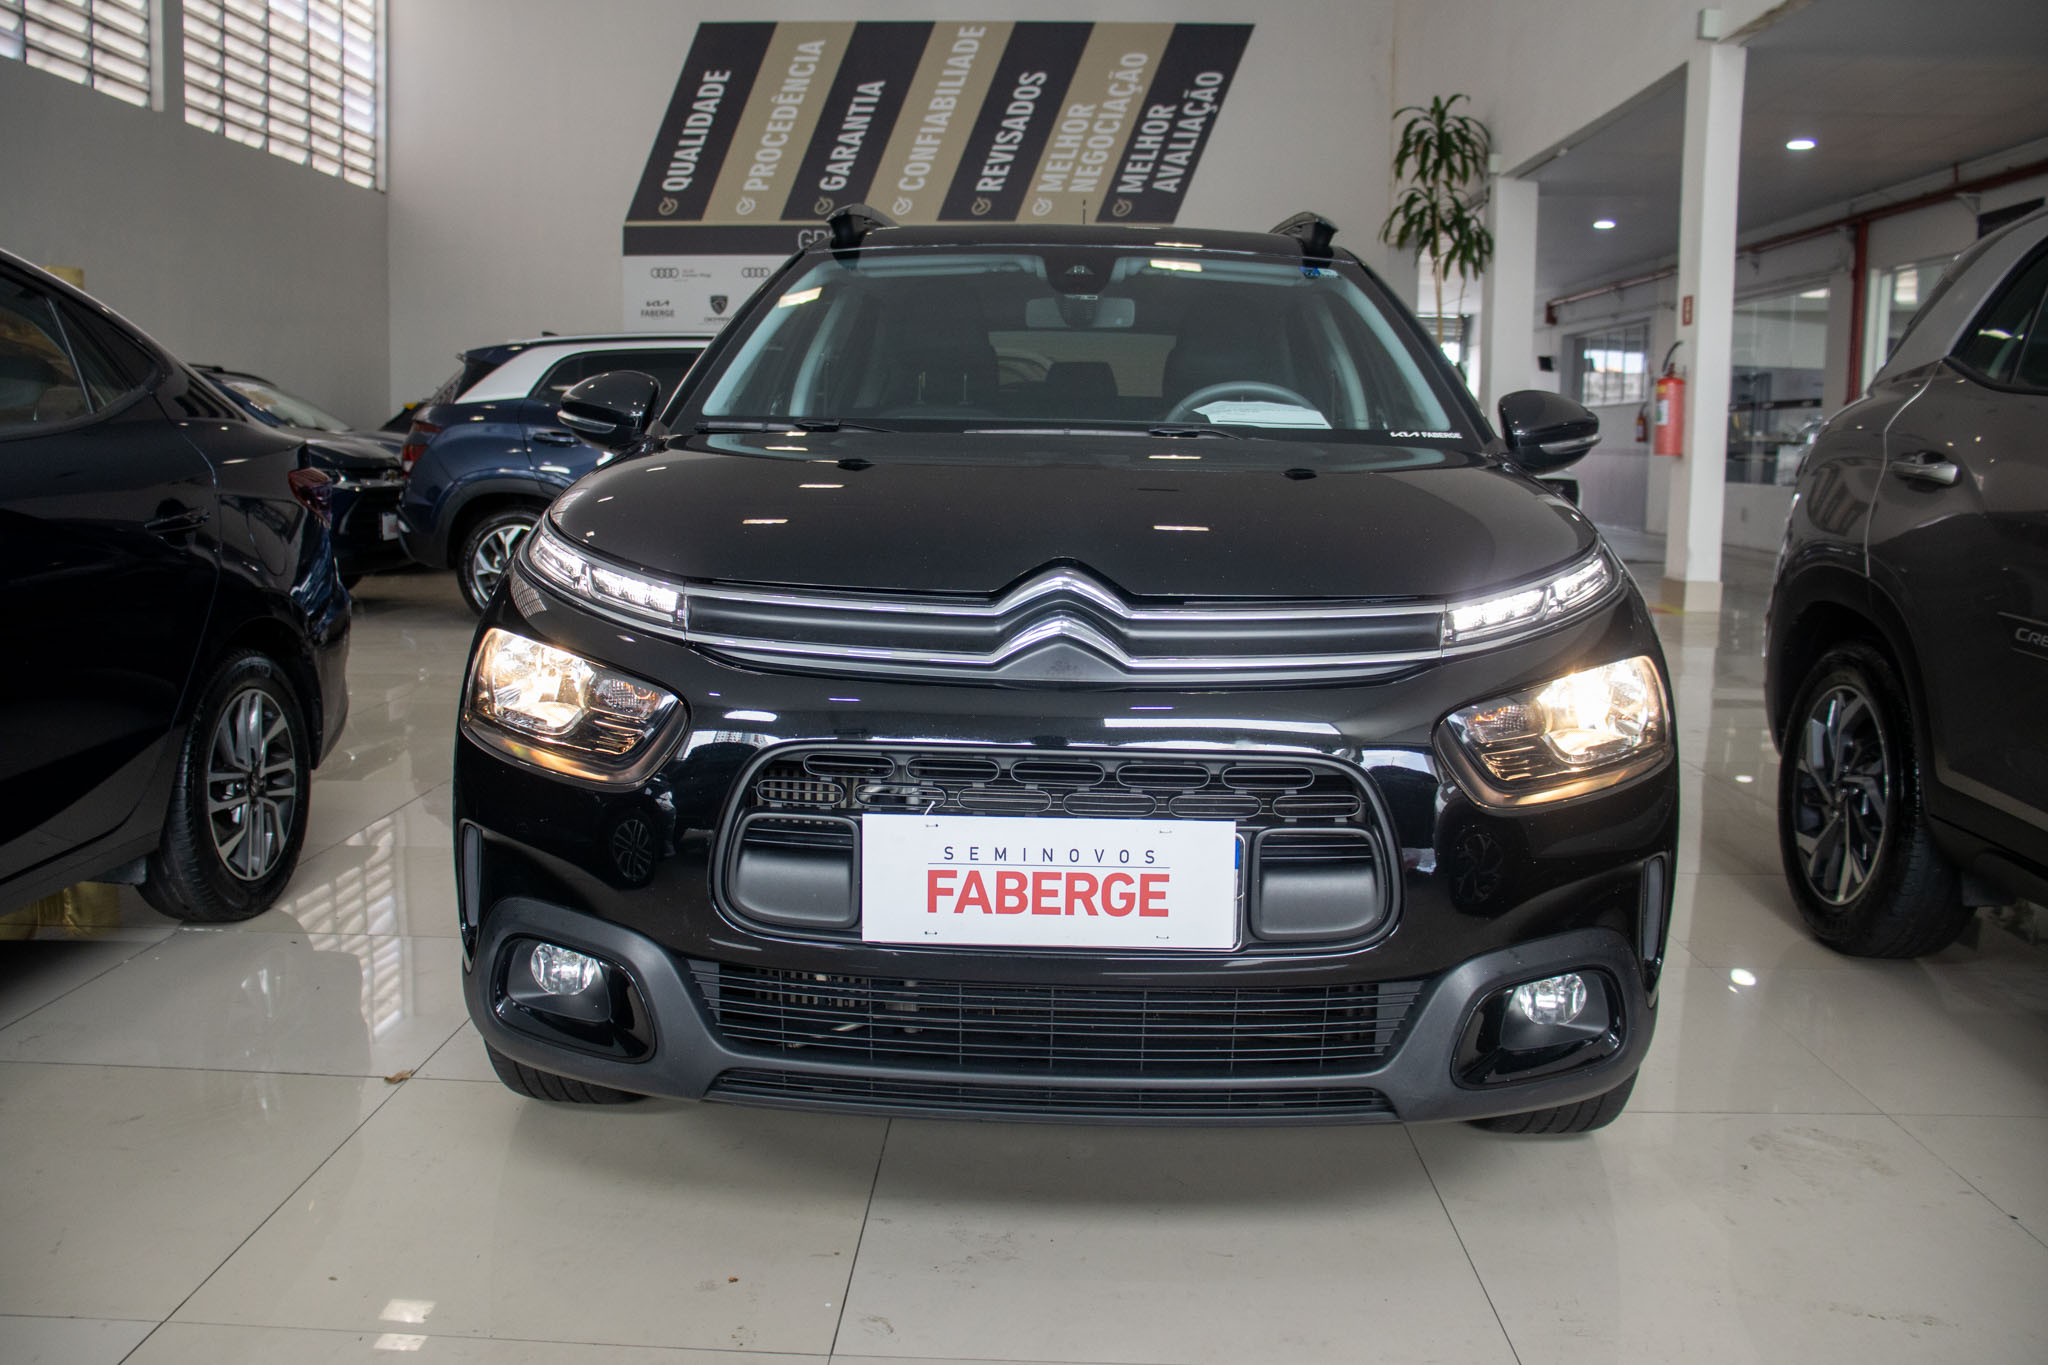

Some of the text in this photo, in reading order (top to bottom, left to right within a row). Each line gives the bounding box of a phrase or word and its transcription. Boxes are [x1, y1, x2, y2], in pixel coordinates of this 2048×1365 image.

[662, 70, 732, 192] QUALIDADE
[744, 40, 826, 191] PROCEDÊNCIA
[819, 80, 886, 191] GARANTIA
[899, 26, 986, 191] CONFIABILIADE
[976, 71, 1047, 192] REVISADOS
[1036, 103, 1097, 192] MELHOR
[1069, 53, 1148, 192] NEGOCIAÇÃO
[1117, 104, 1177, 193] MELHOR
[1152, 71, 1224, 193] AVALIAÇÃO
[640, 309, 675, 318] FABERGE
[927, 870, 1170, 917] FABERGE
[943, 846, 1156, 864] SEMINOVOS
